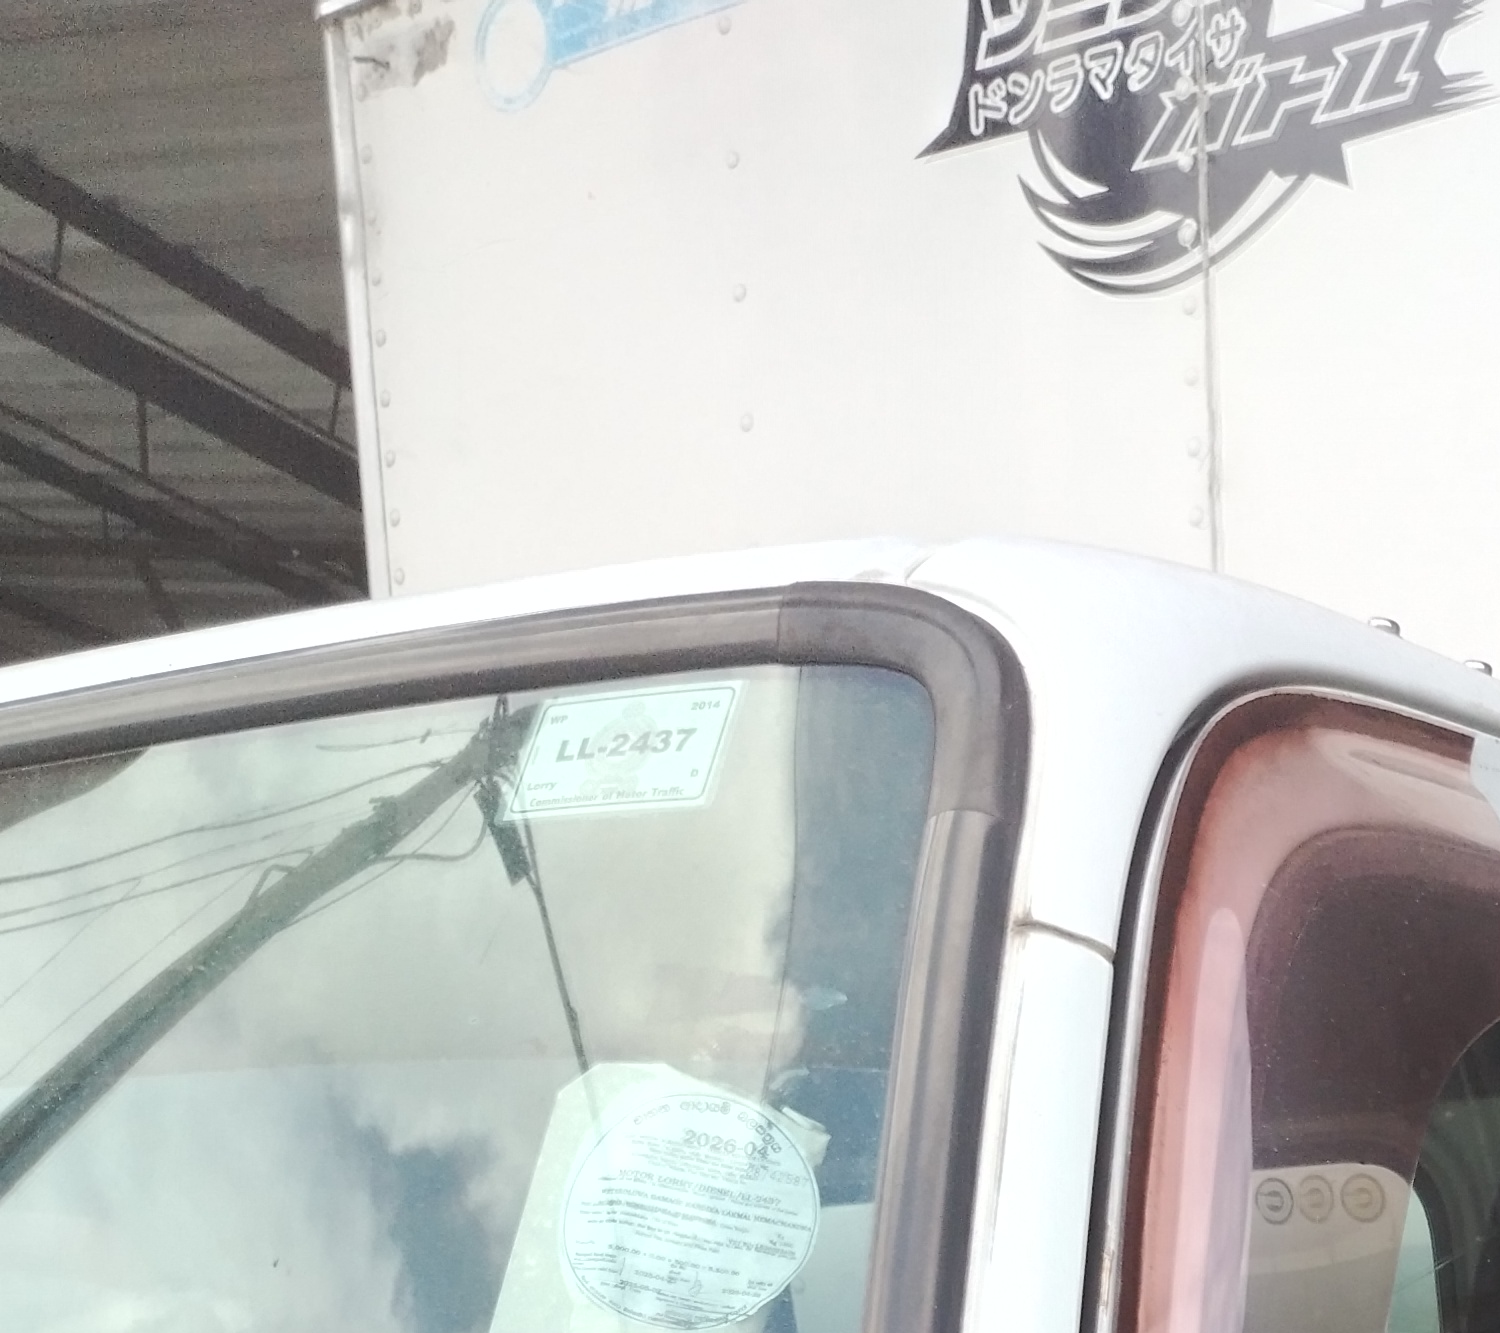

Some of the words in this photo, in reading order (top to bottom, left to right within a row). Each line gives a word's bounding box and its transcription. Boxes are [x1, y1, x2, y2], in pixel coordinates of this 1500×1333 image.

[1130, 20, 1431, 173] バトル
[549, 714, 568, 725] WP
[690, 699, 721, 711] 2014
[555, 727, 698, 763] LL-2437
[527, 781, 557, 792] Lorry
[529, 793, 599, 808] Commissioner
[602, 790, 613, 801] of
[616, 788, 648, 801] Motor
[651, 785, 685, 798] Traffic
[683, 1128, 770, 1160] 2026-04
